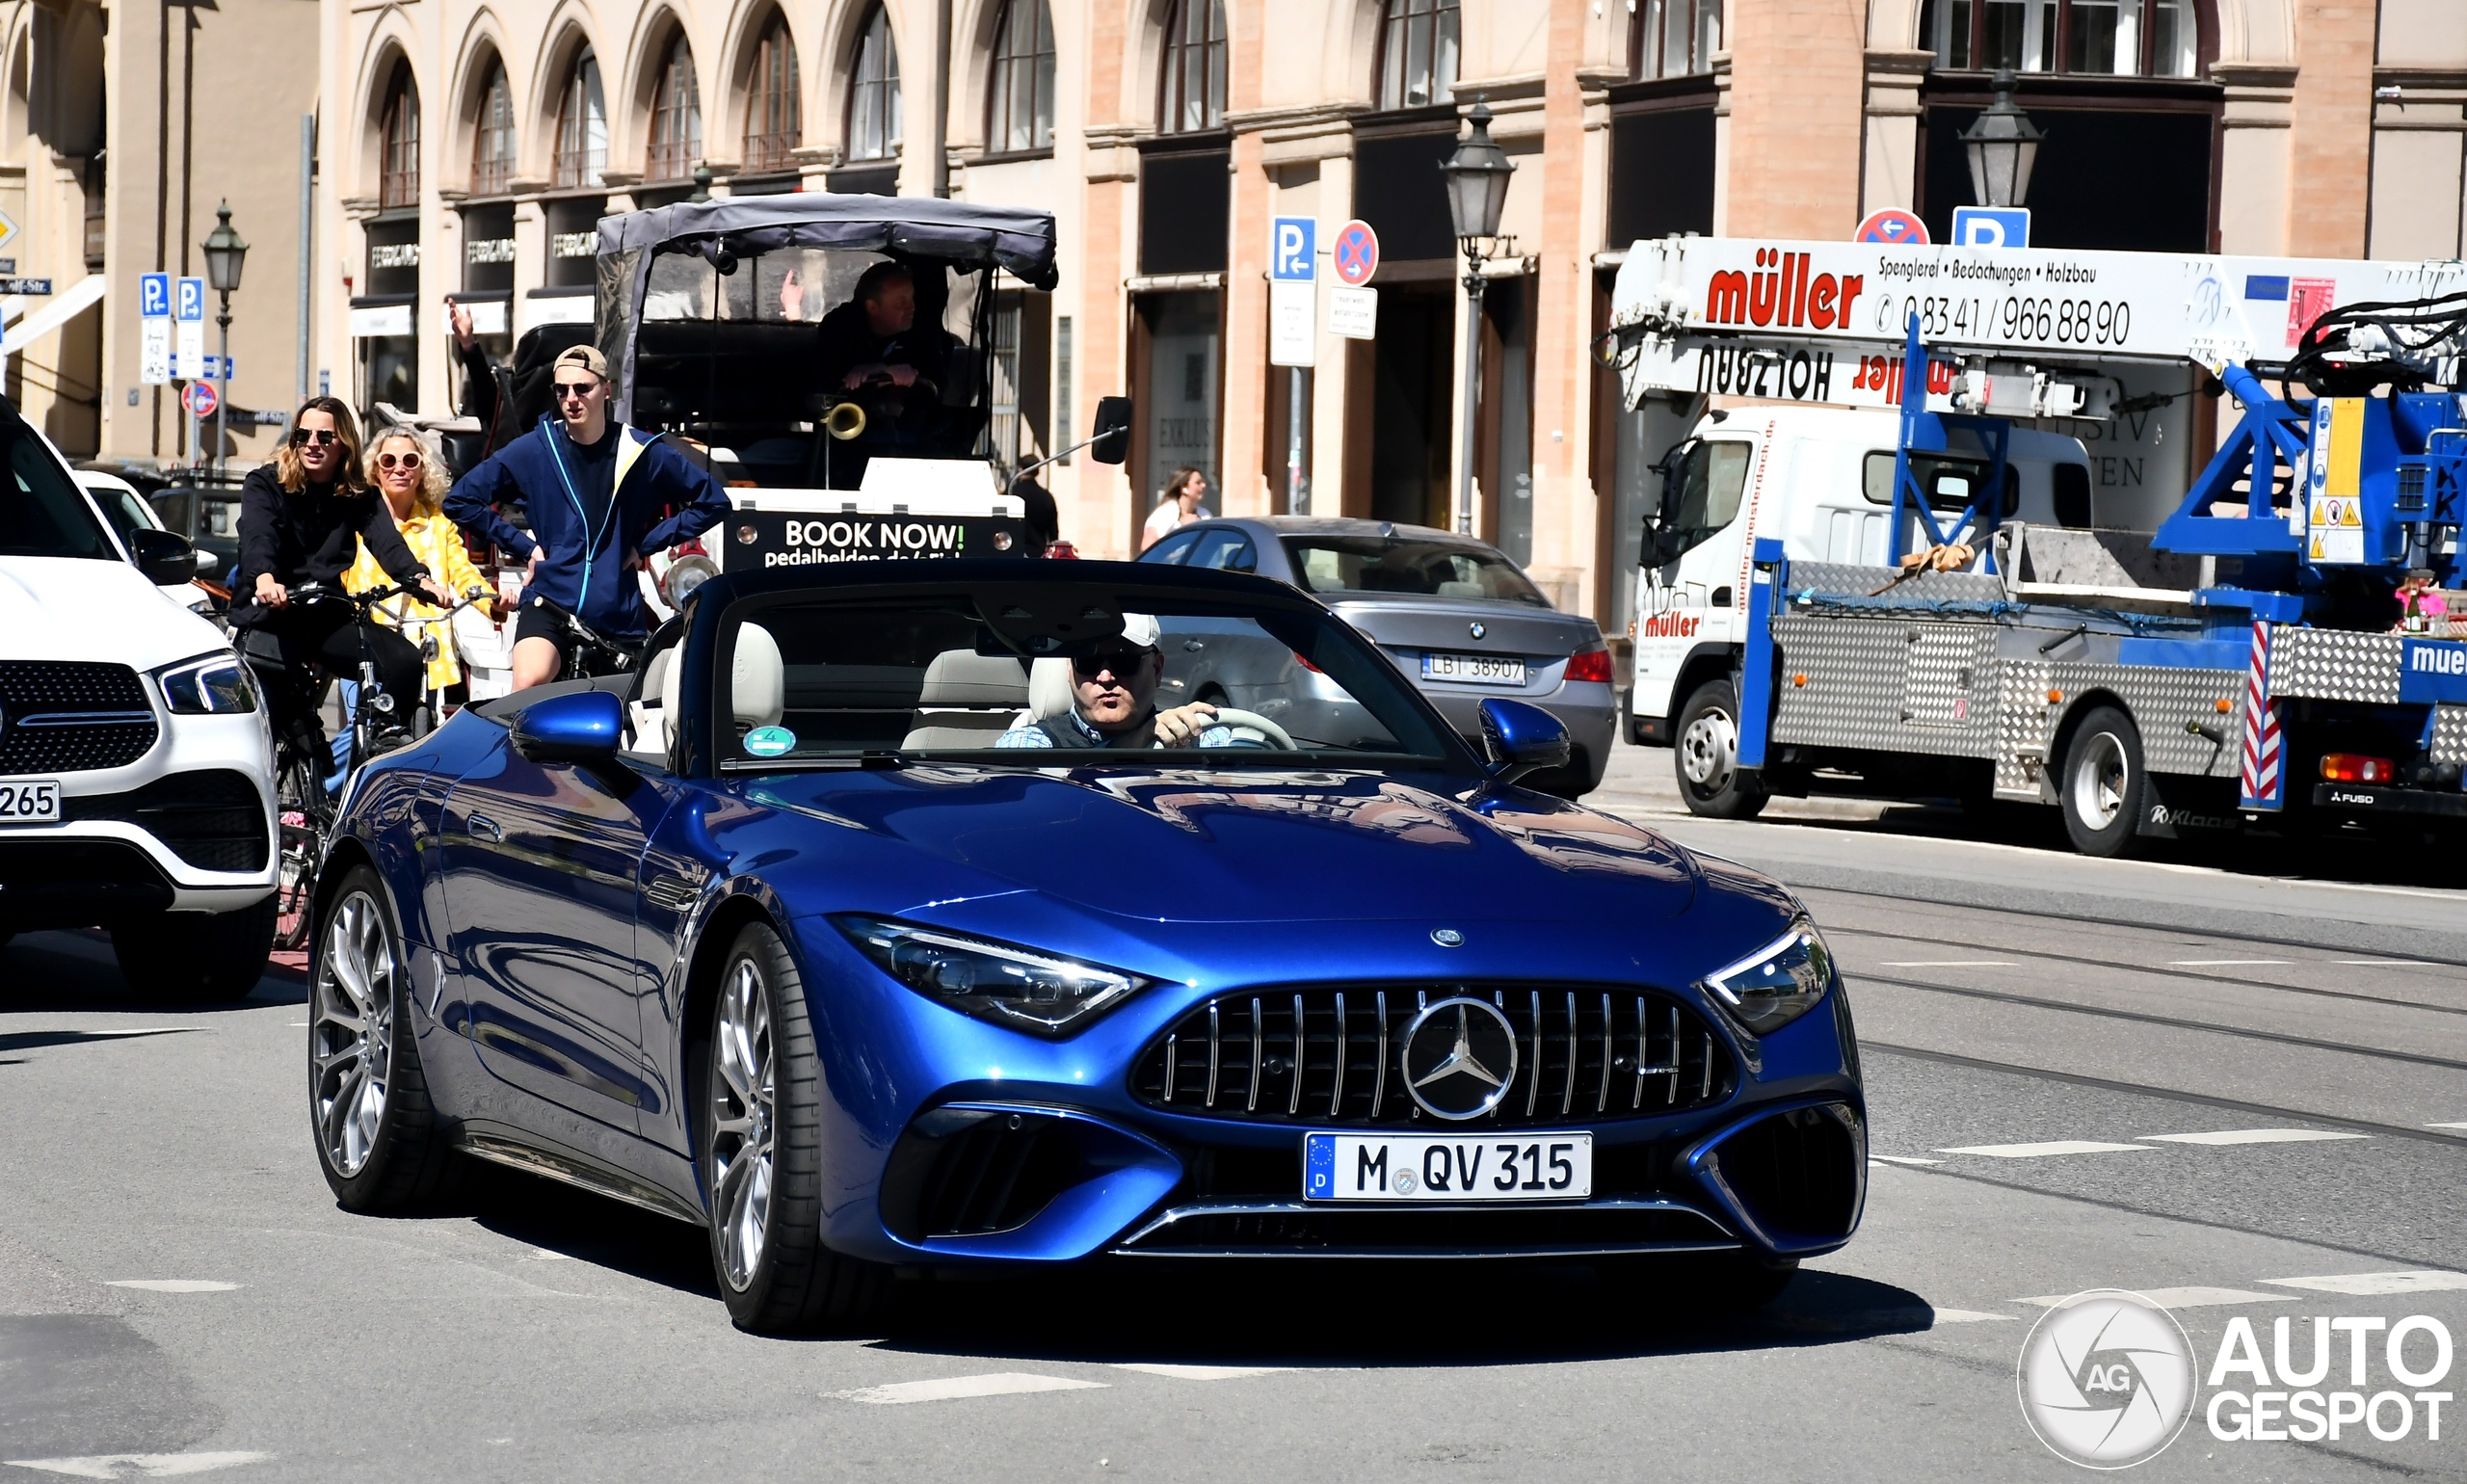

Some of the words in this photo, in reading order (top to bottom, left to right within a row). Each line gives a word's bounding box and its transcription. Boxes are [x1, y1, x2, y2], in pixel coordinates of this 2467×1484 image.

[1879, 256, 1940, 281] Spenglerei
[1951, 259, 2030, 286] Bedachungen
[2045, 262, 2097, 283] Holzbau
[1706, 248, 1864, 330] müller
[785, 520, 872, 547] BOOK
[880, 524, 964, 550] NOW!
[1645, 610, 1700, 637] müller
[1471, 657, 1523, 678] 38907
[2412, 646, 2467, 675] mue
[2343, 793, 2374, 805] FUSO
[1357, 1144, 1389, 1191] M
[1422, 1145, 1484, 1192] QV
[1494, 1143, 1574, 1191] 315
